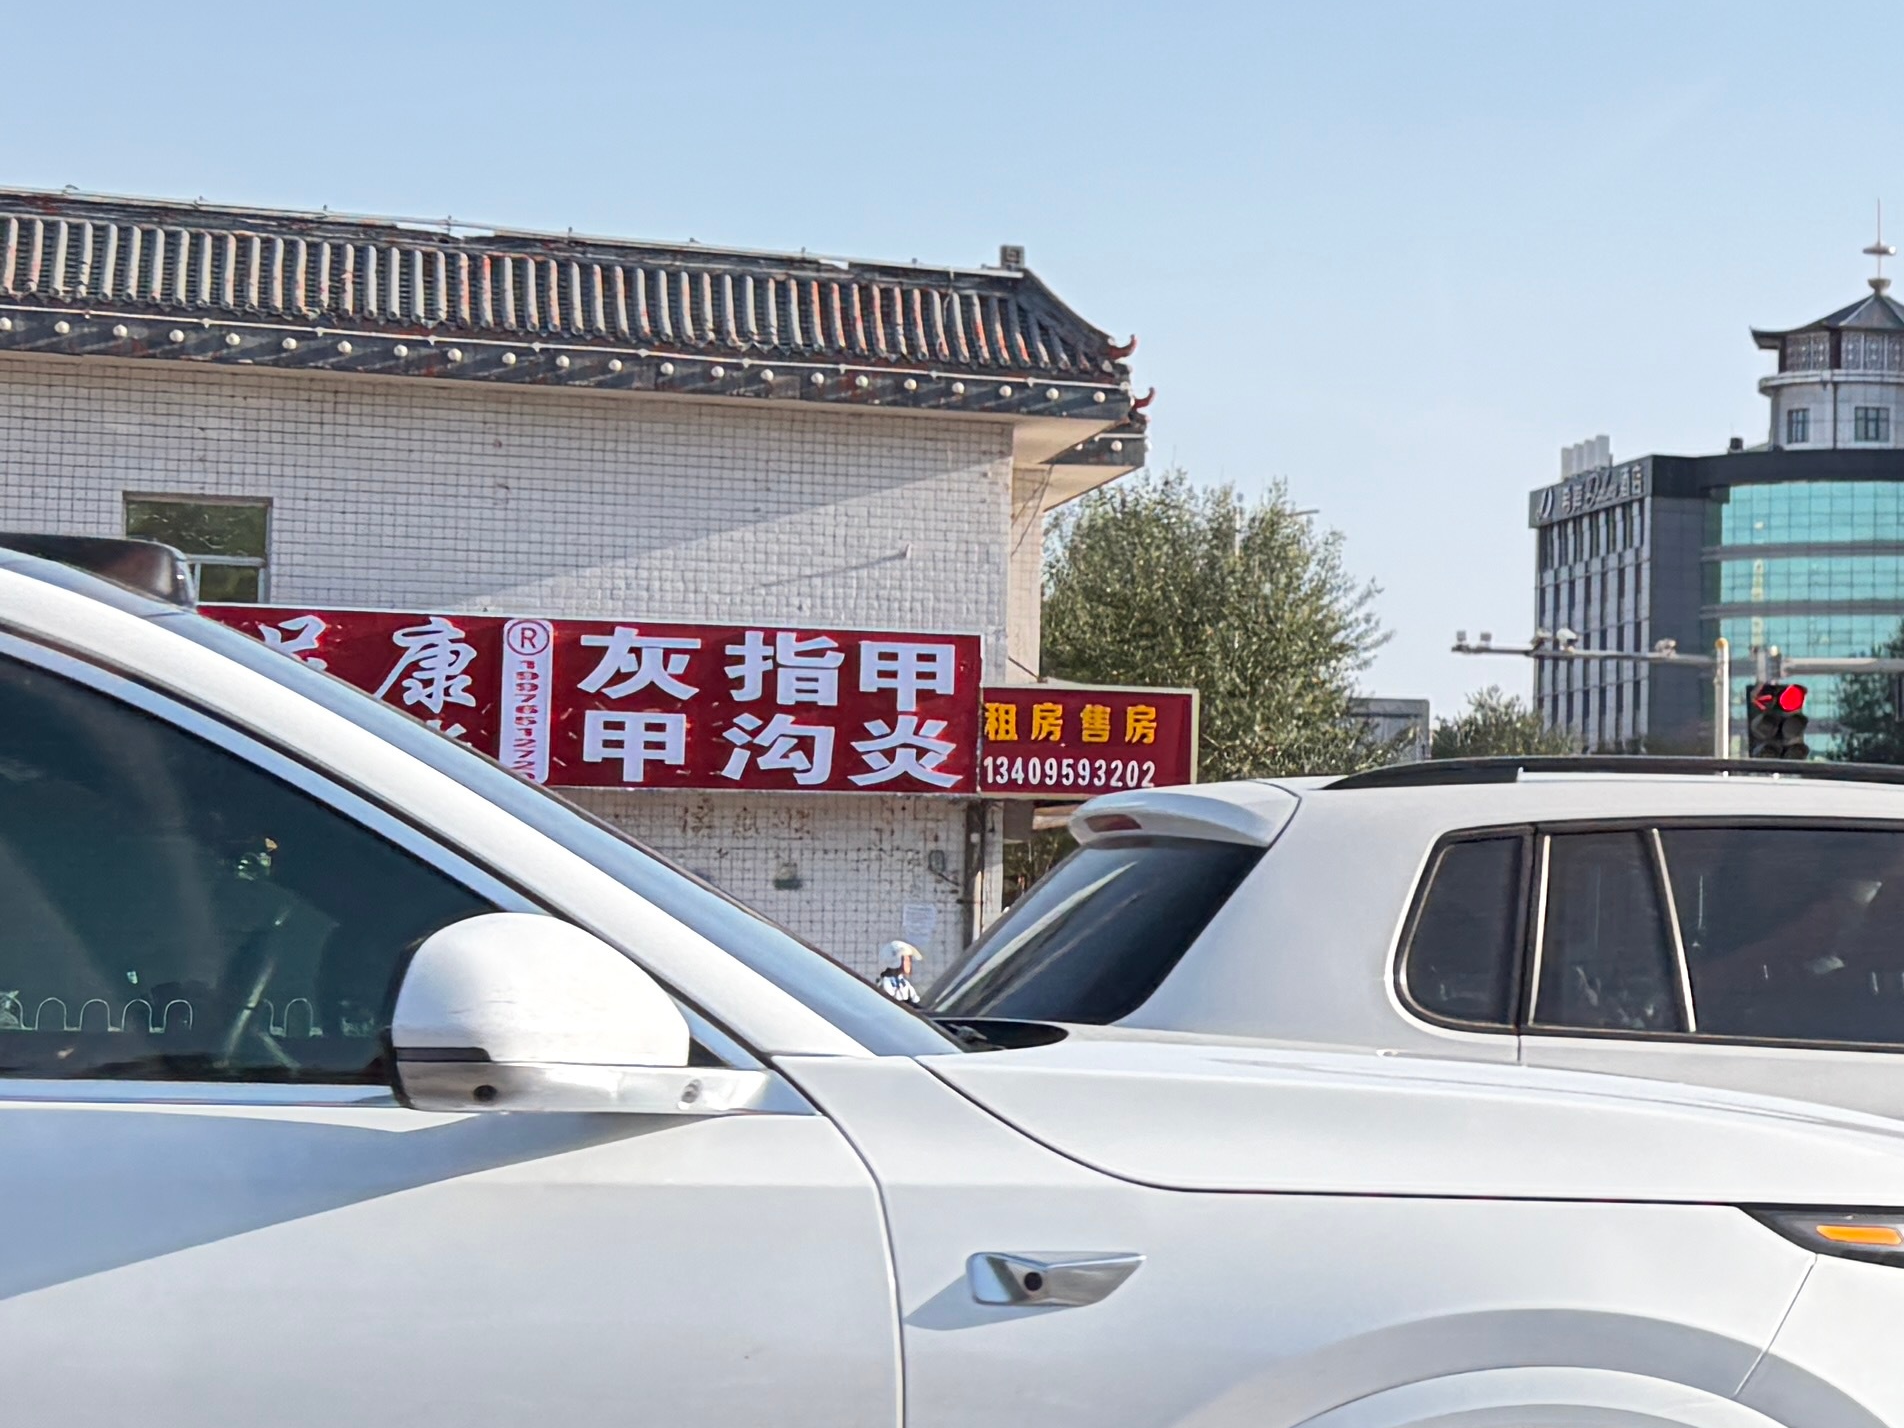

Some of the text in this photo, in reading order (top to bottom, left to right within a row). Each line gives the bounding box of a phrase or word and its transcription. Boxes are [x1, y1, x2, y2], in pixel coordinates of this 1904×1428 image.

[577, 626, 955, 712] 灰指甲
[582, 710, 963, 788] 甲沟炎
[984, 702, 1157, 744] 租房售房
[983, 756, 1156, 788] 13409593202
